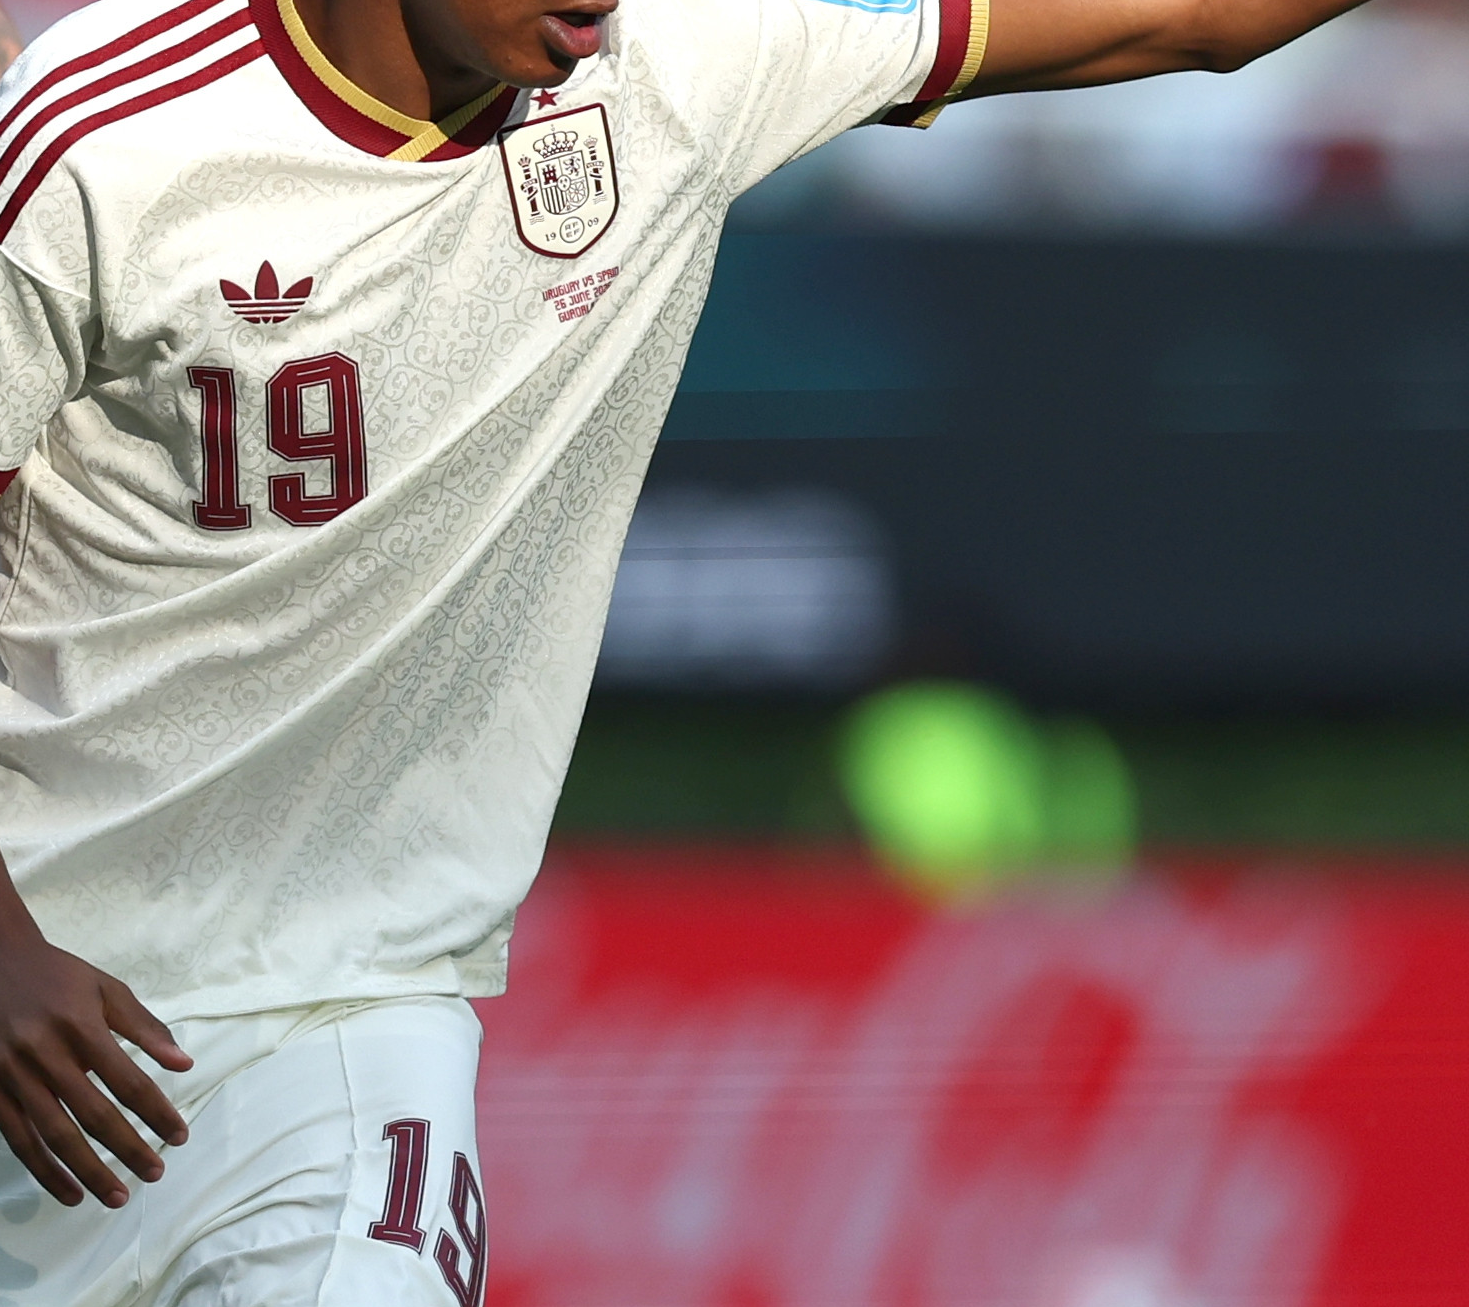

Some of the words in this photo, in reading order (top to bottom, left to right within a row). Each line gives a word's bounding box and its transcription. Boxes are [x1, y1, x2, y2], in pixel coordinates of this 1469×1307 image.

[542, 280, 581, 302] URUGUAY
[582, 275, 595, 287] VS
[554, 298, 567, 311] 26
[569, 290, 592, 306] JUNE
[185, 351, 369, 531] 19
